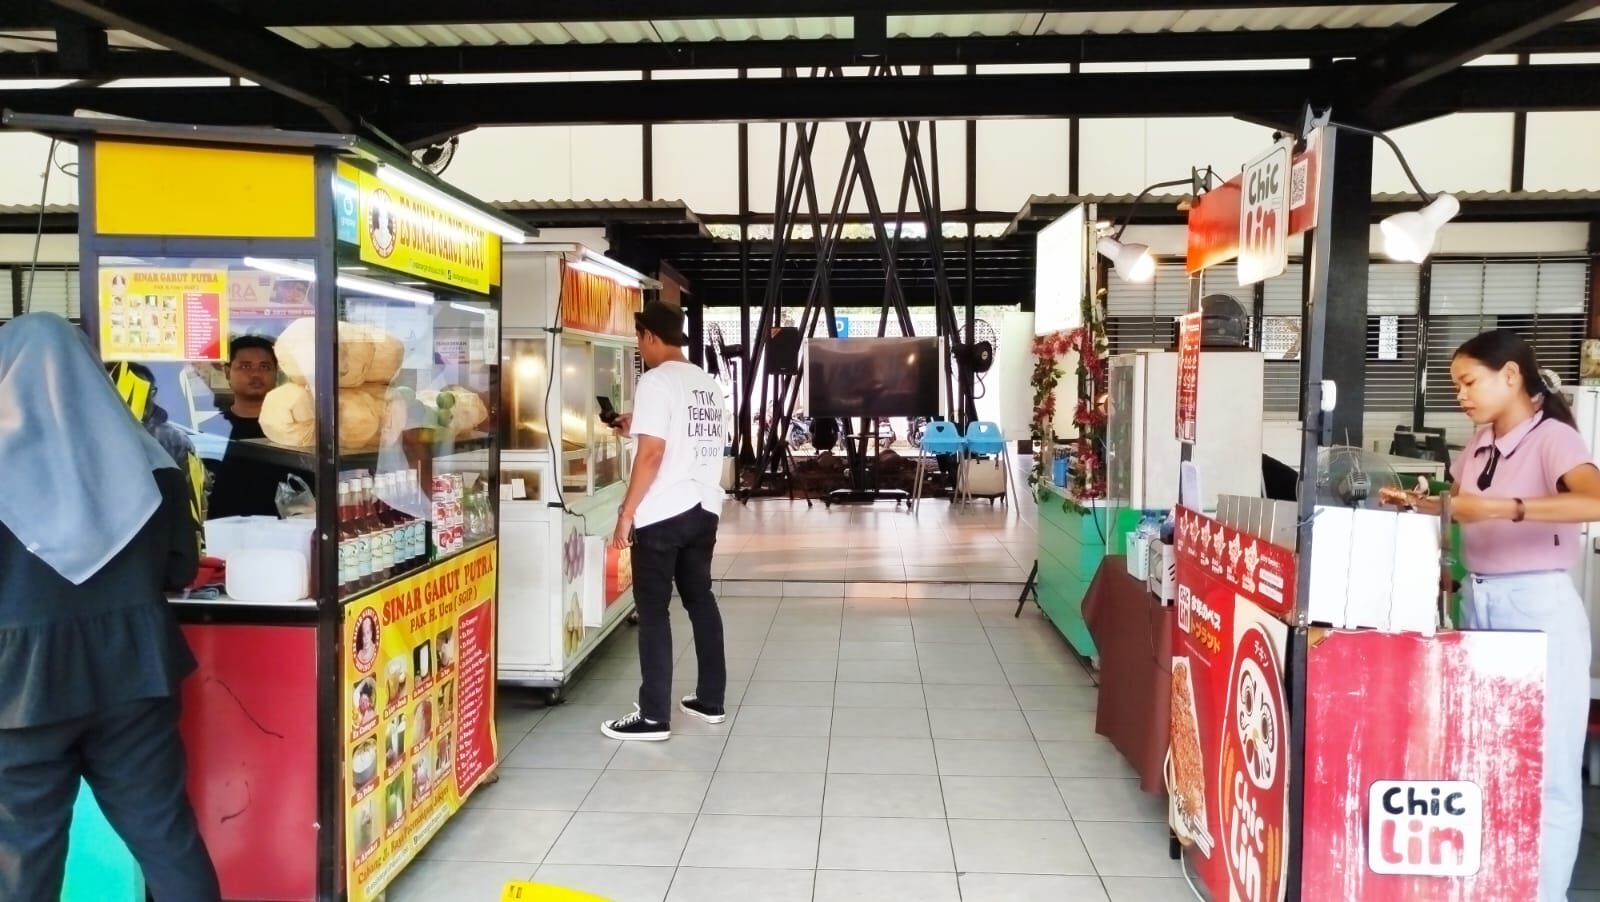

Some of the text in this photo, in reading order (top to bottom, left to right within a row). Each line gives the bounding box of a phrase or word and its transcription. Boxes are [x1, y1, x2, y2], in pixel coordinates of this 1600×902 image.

[1249, 163, 1279, 205] Chic
[382, 553, 494, 627] SINAR GARUT PUTRA
[410, 612, 427, 634] PAK
[439, 601, 453, 618] Ucu
[1234, 771, 1264, 853] Chic
[1382, 787, 1466, 816] Chic
[1231, 805, 1261, 902] Lin
[1381, 819, 1464, 866] Lin
